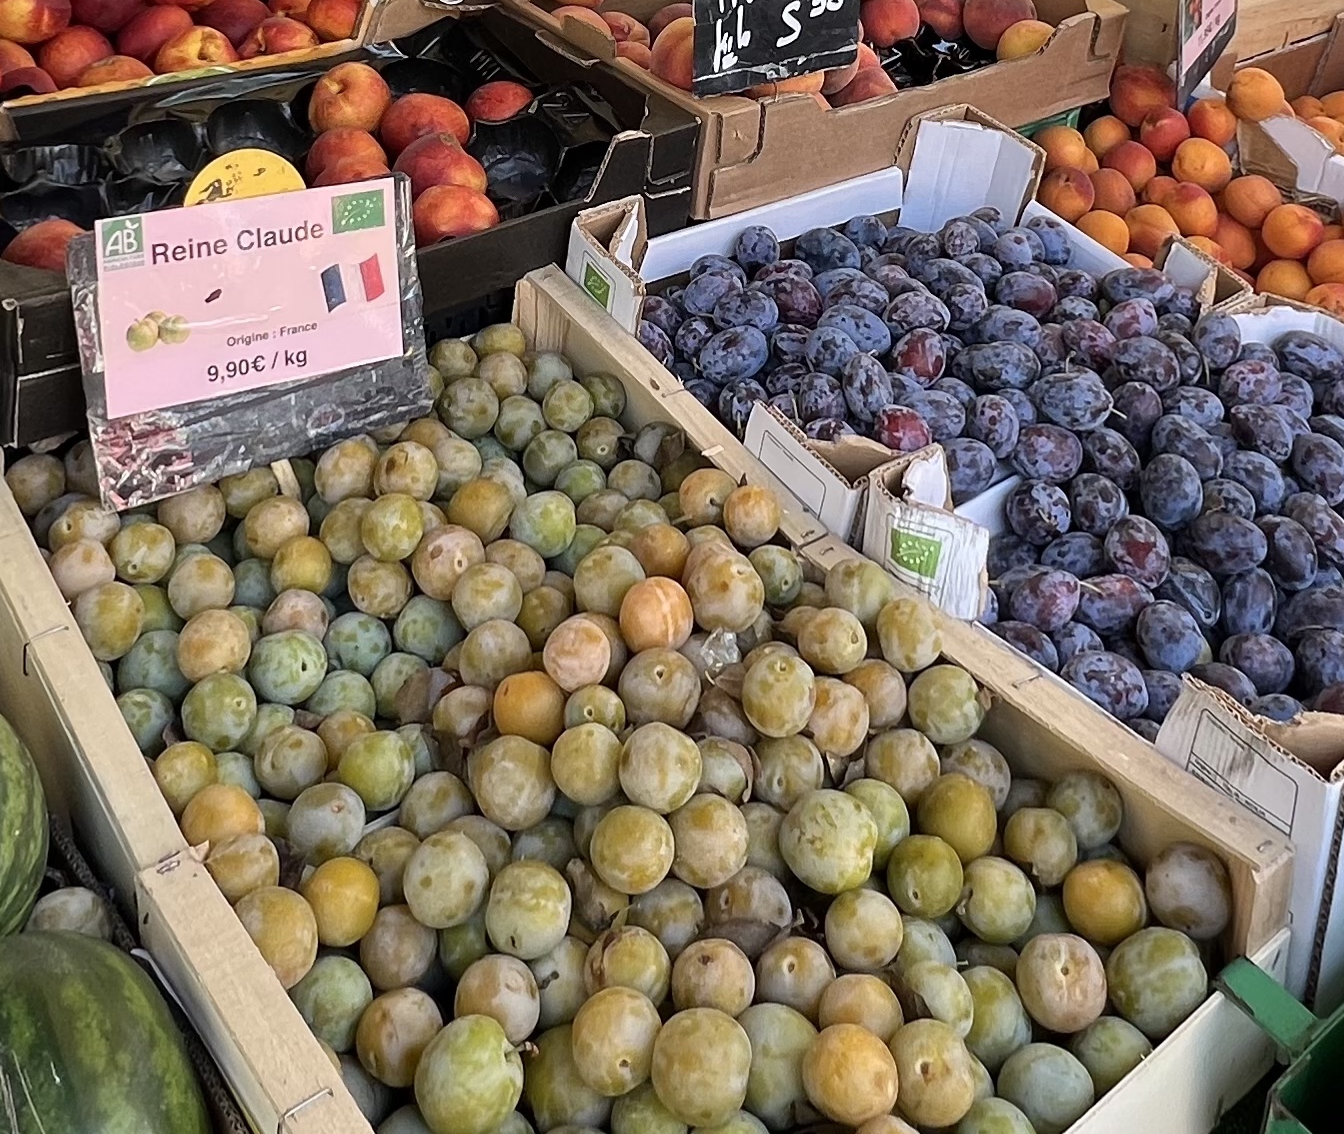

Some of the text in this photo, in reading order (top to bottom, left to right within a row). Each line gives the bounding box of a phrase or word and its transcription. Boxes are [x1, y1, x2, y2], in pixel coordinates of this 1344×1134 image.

[105, 229, 138, 257] AB
[151, 234, 228, 265] Reine
[237, 219, 325, 252] Claude
[226, 328, 270, 348] Origine
[279, 320, 318, 338] France
[207, 355, 266, 384] 9,90€
[285, 349, 309, 368] kg
